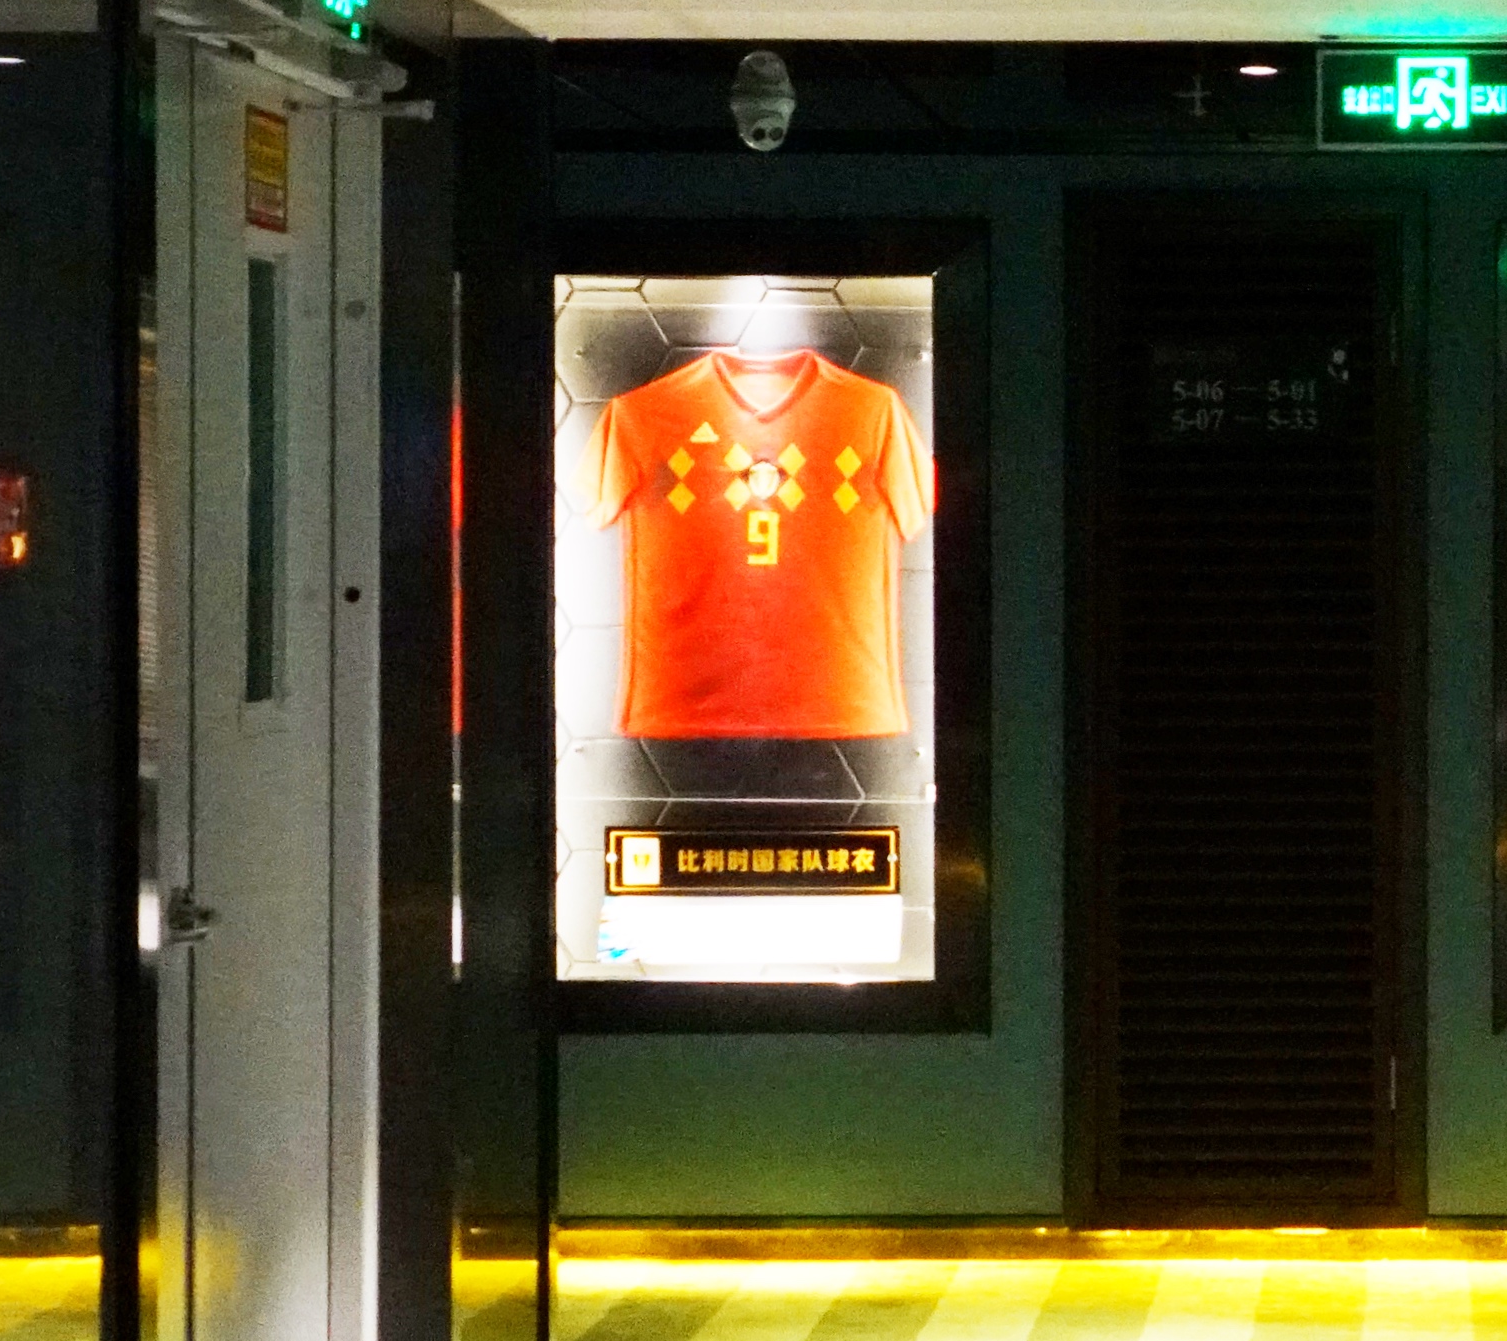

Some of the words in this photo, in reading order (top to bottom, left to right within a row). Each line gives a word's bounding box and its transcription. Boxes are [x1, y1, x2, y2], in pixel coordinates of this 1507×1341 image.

[747, 510, 780, 565] 9
[677, 848, 875, 873] 比利时国家队球衣
